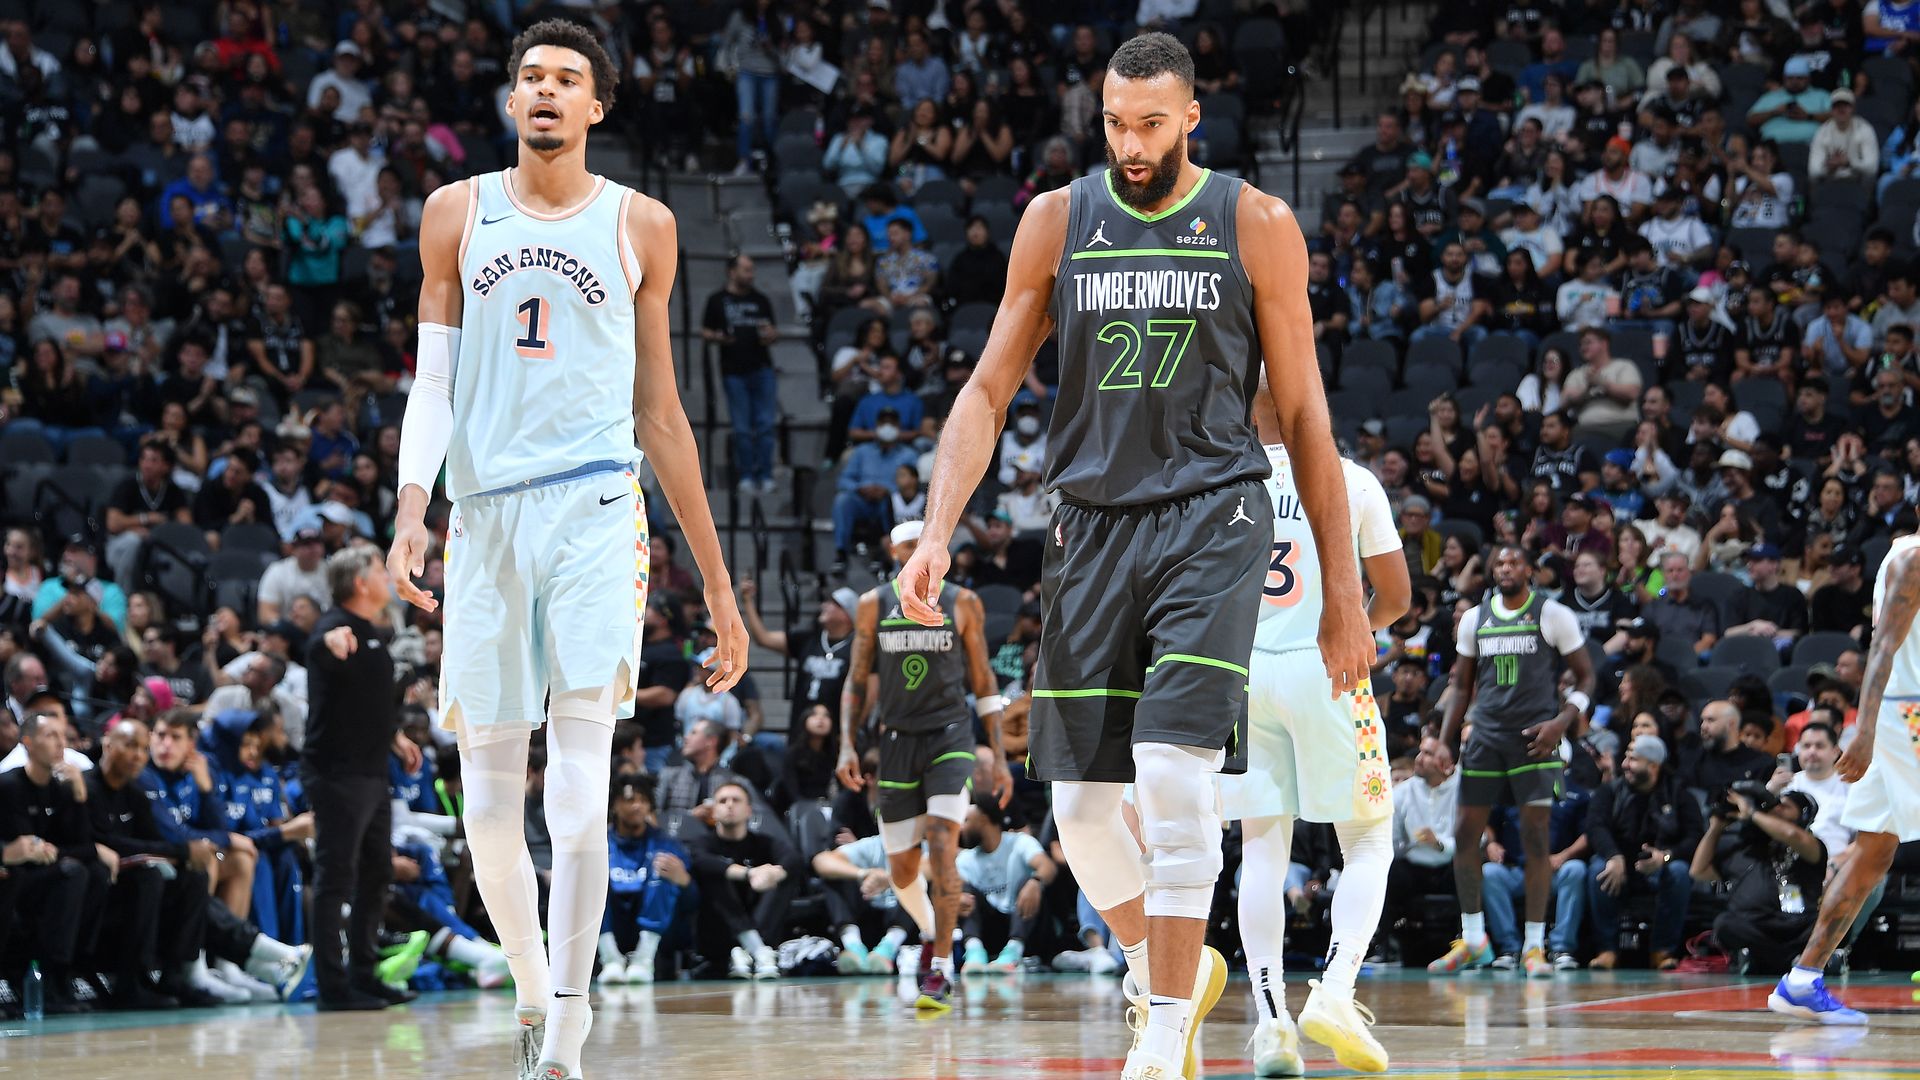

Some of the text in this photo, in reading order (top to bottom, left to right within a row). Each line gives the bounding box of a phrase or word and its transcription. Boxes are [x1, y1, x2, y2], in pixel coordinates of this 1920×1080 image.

[1176, 234, 1218, 246] sezzle
[473, 248, 606, 305] SAN ANTONIO
[1073, 270, 1222, 316] TIMBERWOLVES
[515, 297, 549, 353] 1
[1096, 319, 1197, 390] 27
[1273, 495, 1301, 521] UL
[1262, 540, 1297, 600] 3
[878, 630, 954, 653] TIMBERWOLVES
[1478, 635, 1538, 657] TIMBERWOLVES
[902, 654, 929, 690] 9
[1494, 655, 1519, 686] 11
[1144, 1065, 1162, 1077] 27
